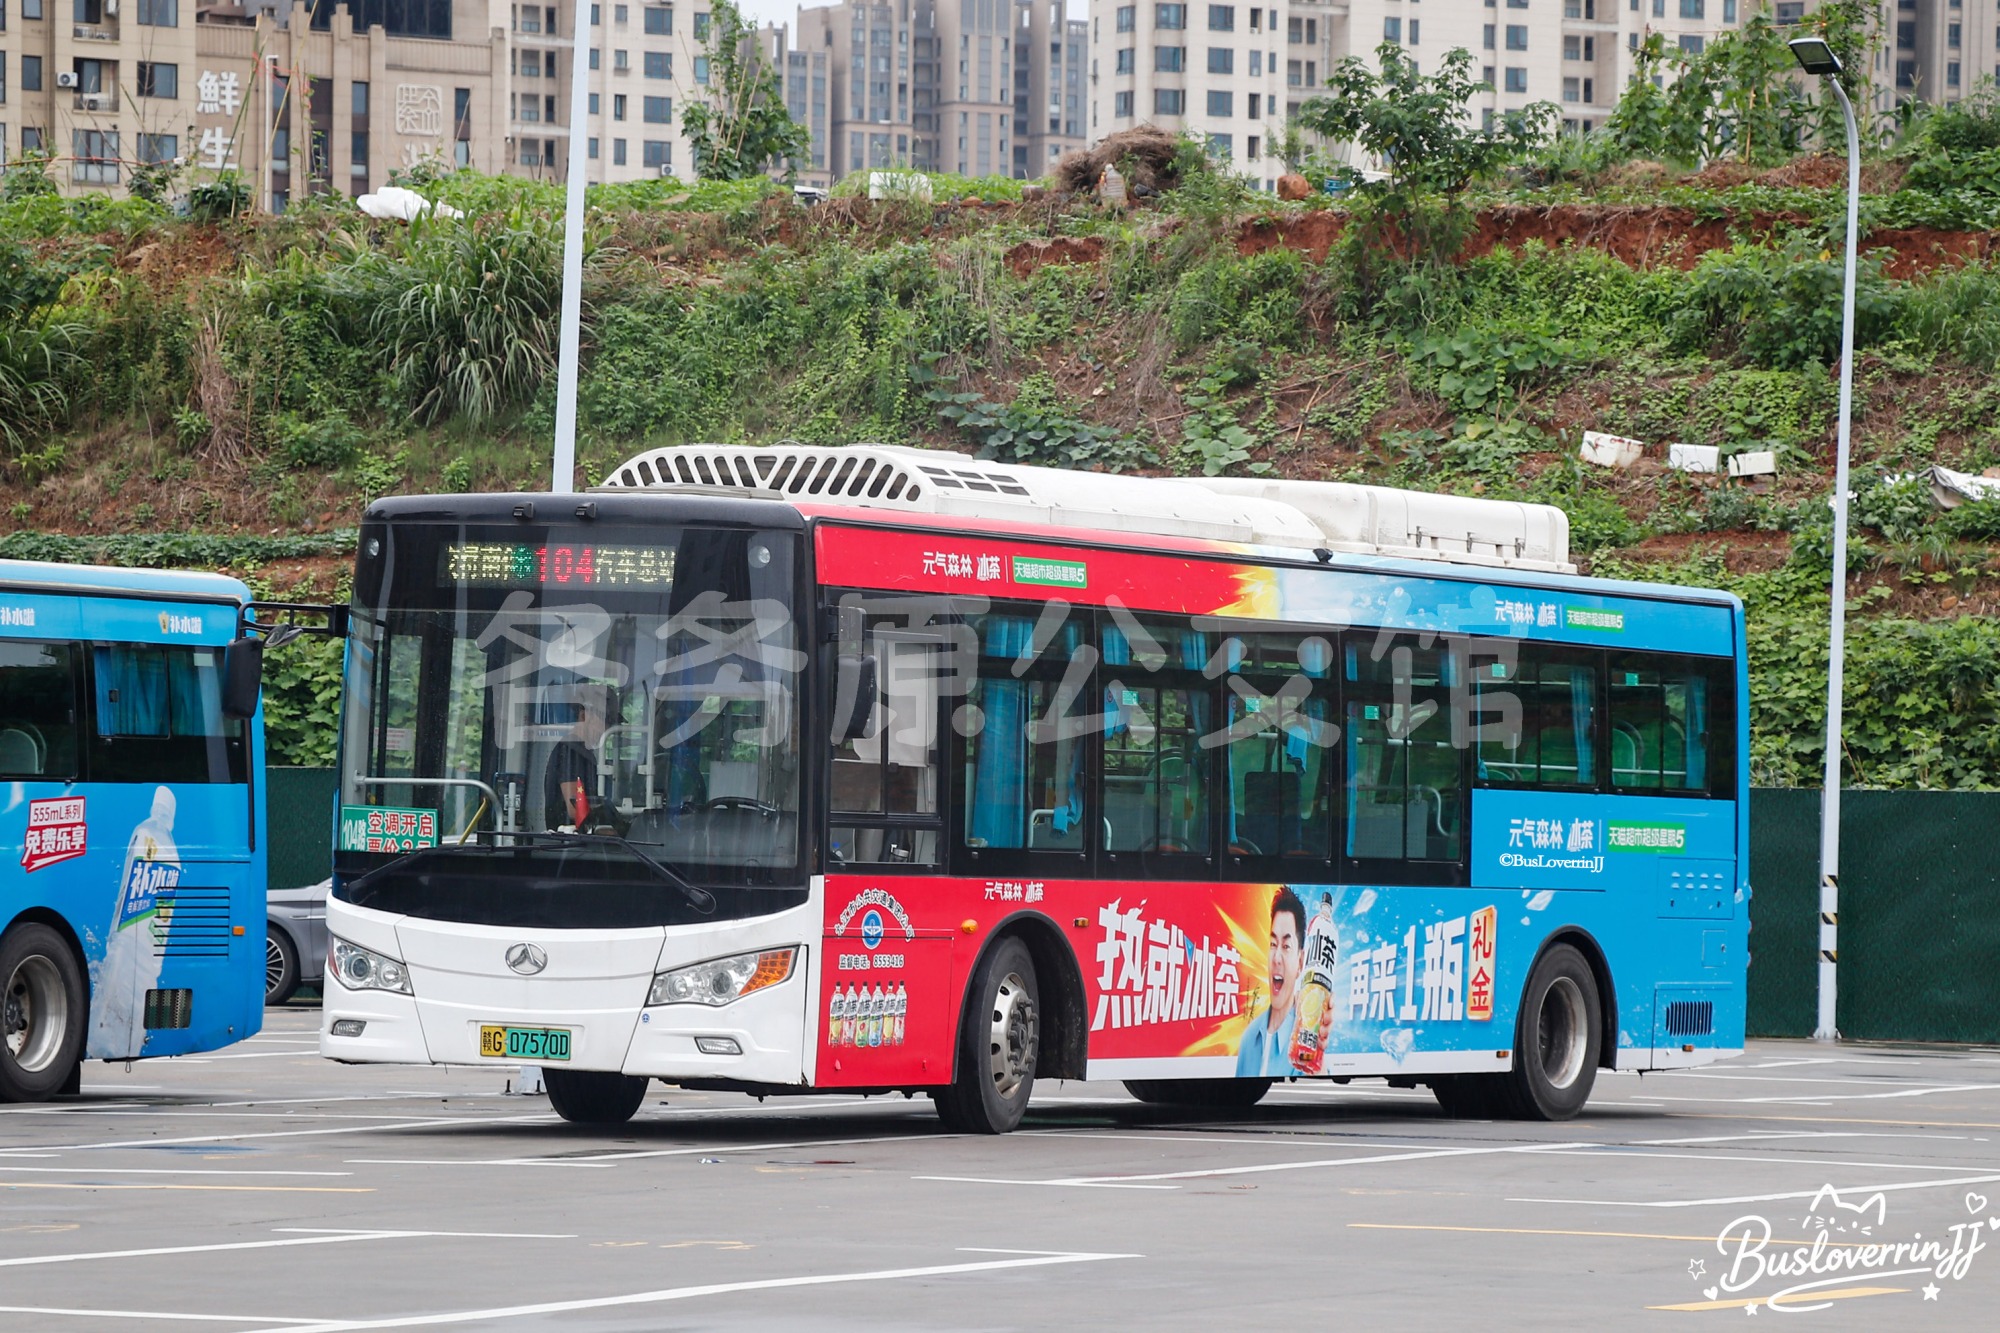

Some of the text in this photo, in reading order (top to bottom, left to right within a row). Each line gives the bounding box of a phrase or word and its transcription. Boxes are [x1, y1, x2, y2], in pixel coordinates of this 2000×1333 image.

[536, 548, 593, 582] 104
[923, 551, 973, 578] 元气森林
[1495, 600, 1535, 624] 元气森林
[368, 811, 434, 837] 空调开启
[1509, 818, 1564, 849] 元气森林
[22, 826, 86, 864] 免费乐享
[985, 881, 1022, 901] 元气森林
[1350, 916, 1466, 1021] 再来1瓶
[1470, 916, 1492, 1012] 礼金
